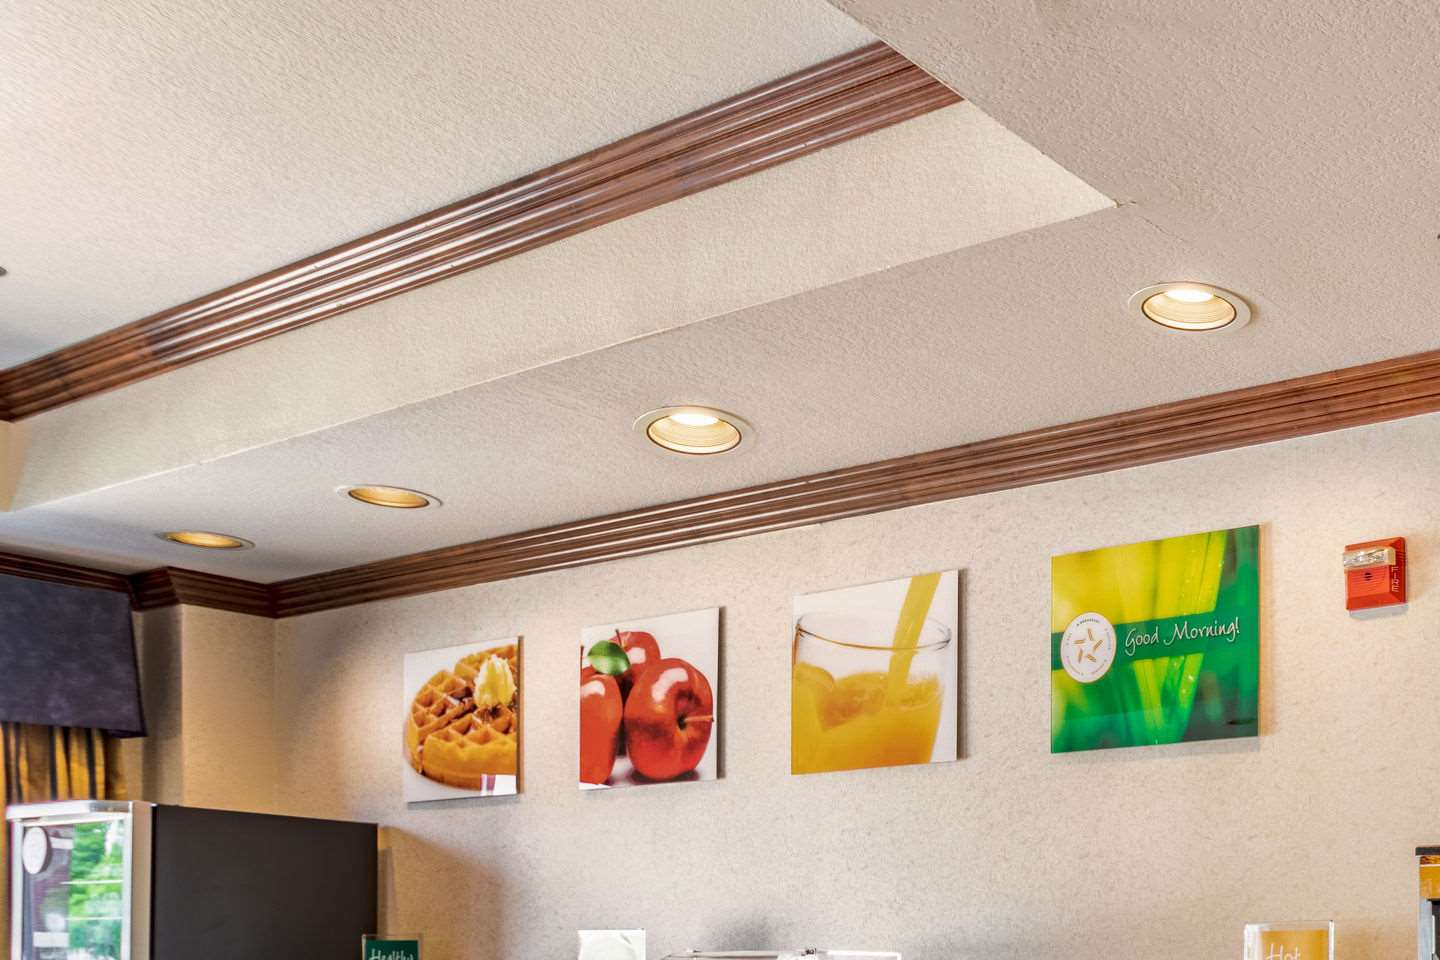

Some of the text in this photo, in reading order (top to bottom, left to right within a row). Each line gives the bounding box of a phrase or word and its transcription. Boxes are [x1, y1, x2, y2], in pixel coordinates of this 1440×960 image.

[1391, 566, 1400, 592] FIRE
[1124, 626, 1160, 656] Good
[1163, 616, 1241, 646] Morning!
